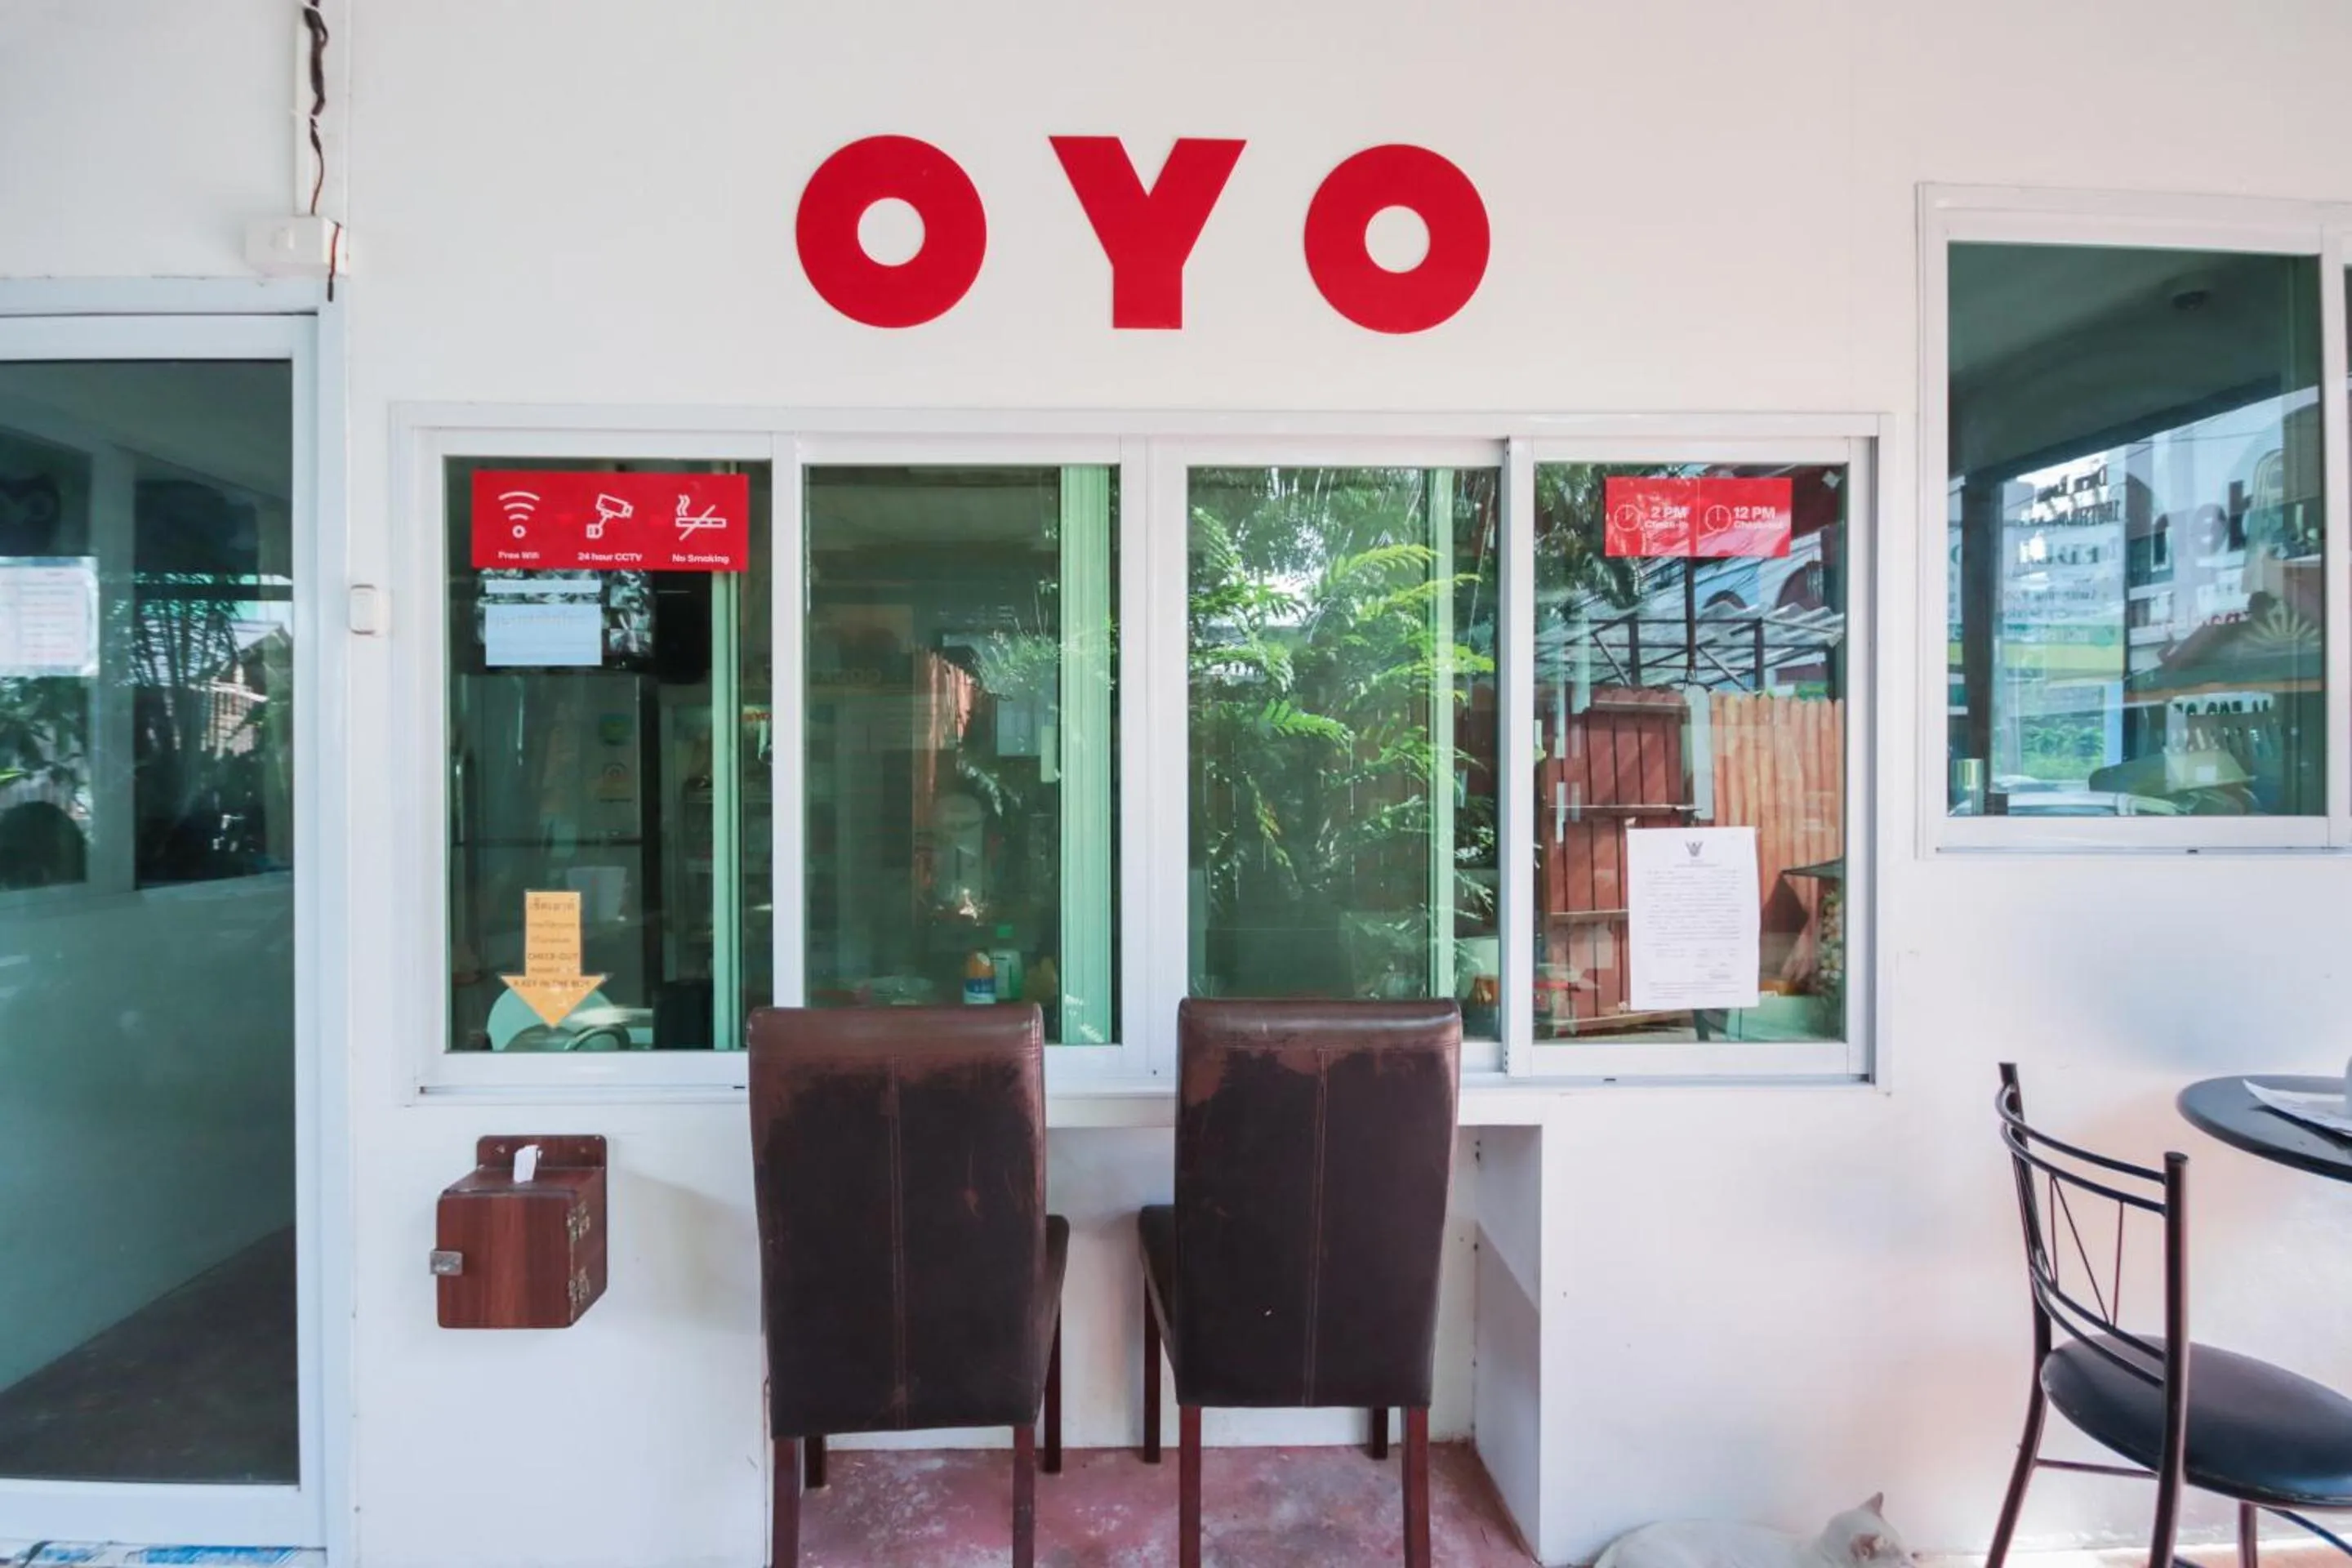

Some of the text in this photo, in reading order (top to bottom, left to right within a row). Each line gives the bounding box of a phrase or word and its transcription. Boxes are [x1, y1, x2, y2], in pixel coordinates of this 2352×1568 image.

[795, 134, 1490, 334] OYO
[1650, 506, 1688, 519] 2 PM
[1733, 506, 1775, 519] 12 PM
[497, 550, 519, 559] Free
[577, 551, 643, 562] 24 hour CCTV
[671, 553, 730, 565] No Smoking
